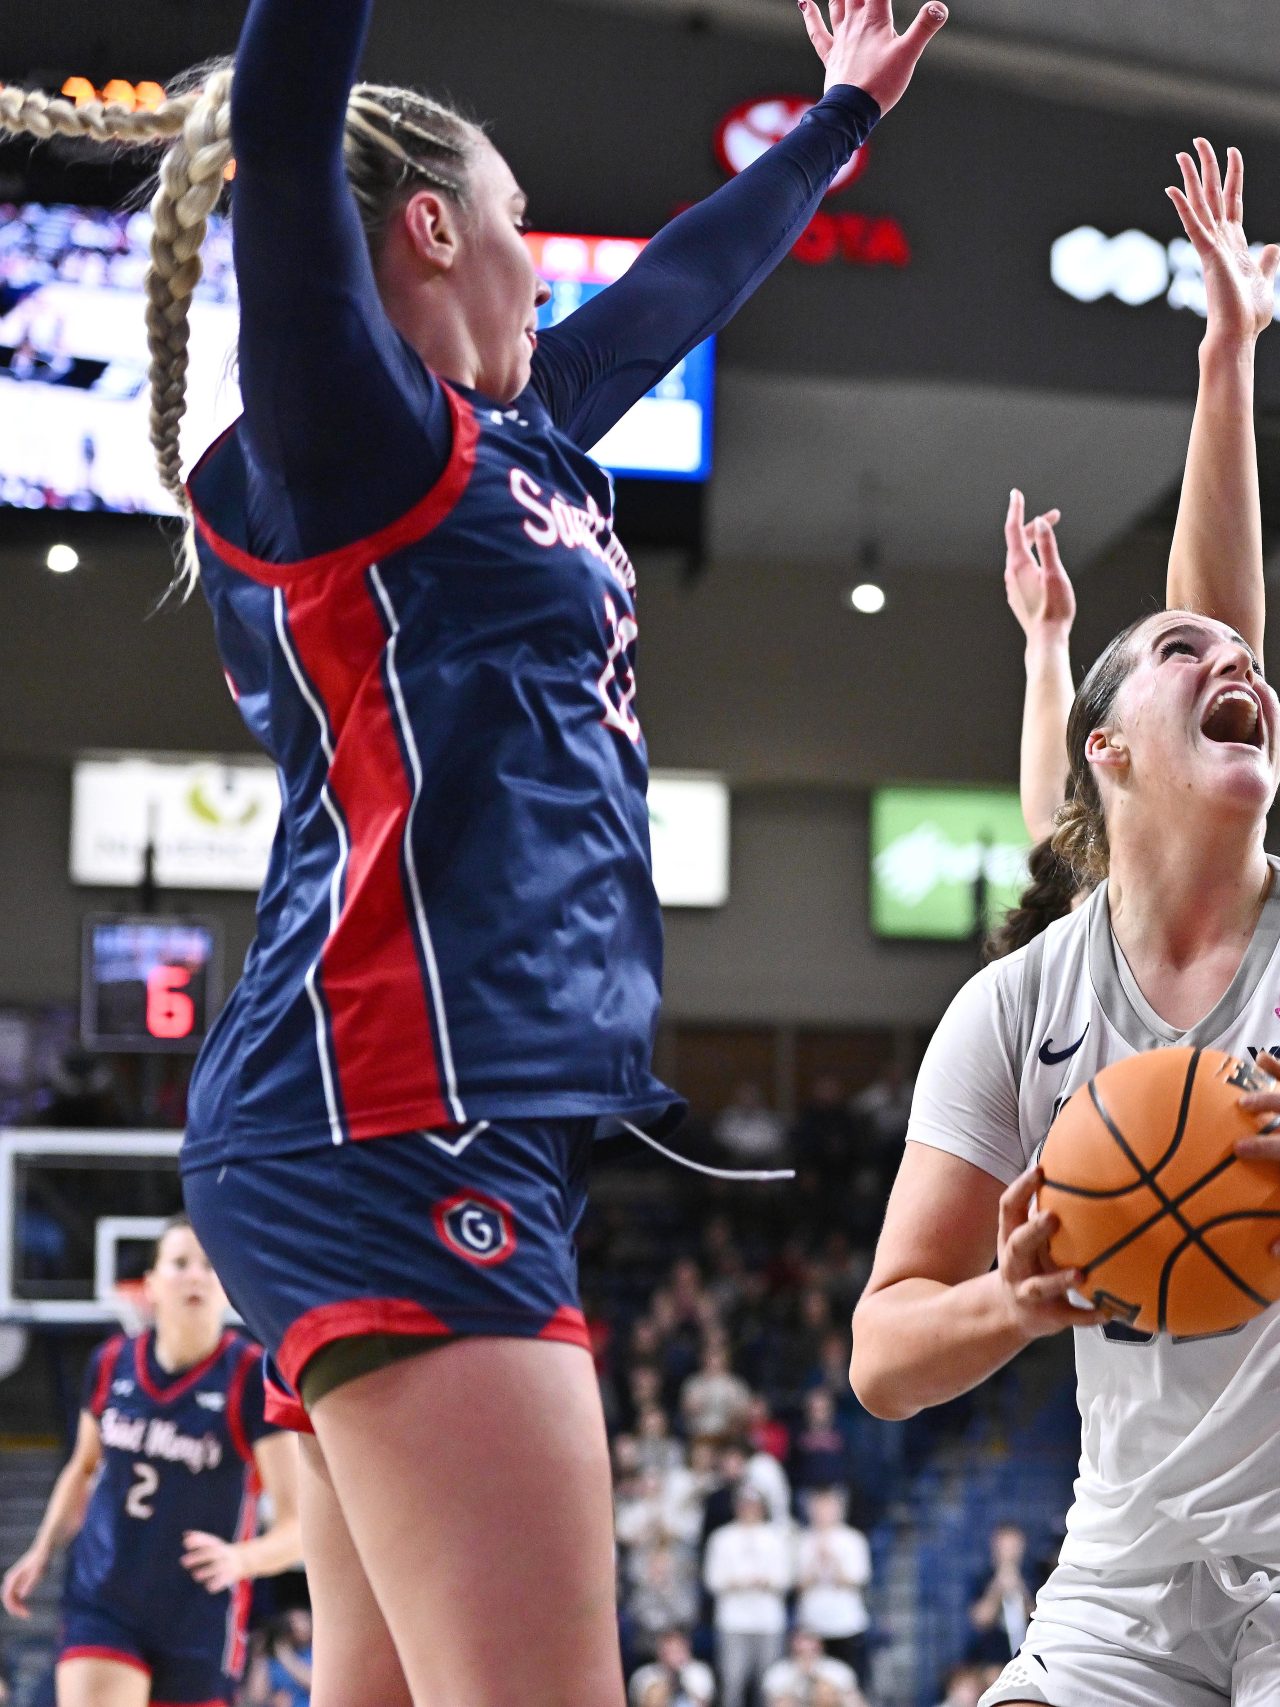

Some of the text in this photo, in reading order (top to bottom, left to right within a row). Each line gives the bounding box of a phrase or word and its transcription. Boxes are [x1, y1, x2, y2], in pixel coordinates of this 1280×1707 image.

[146, 965, 195, 1038] 6
[461, 1210, 493, 1250] G
[126, 1461, 160, 1519] 2
